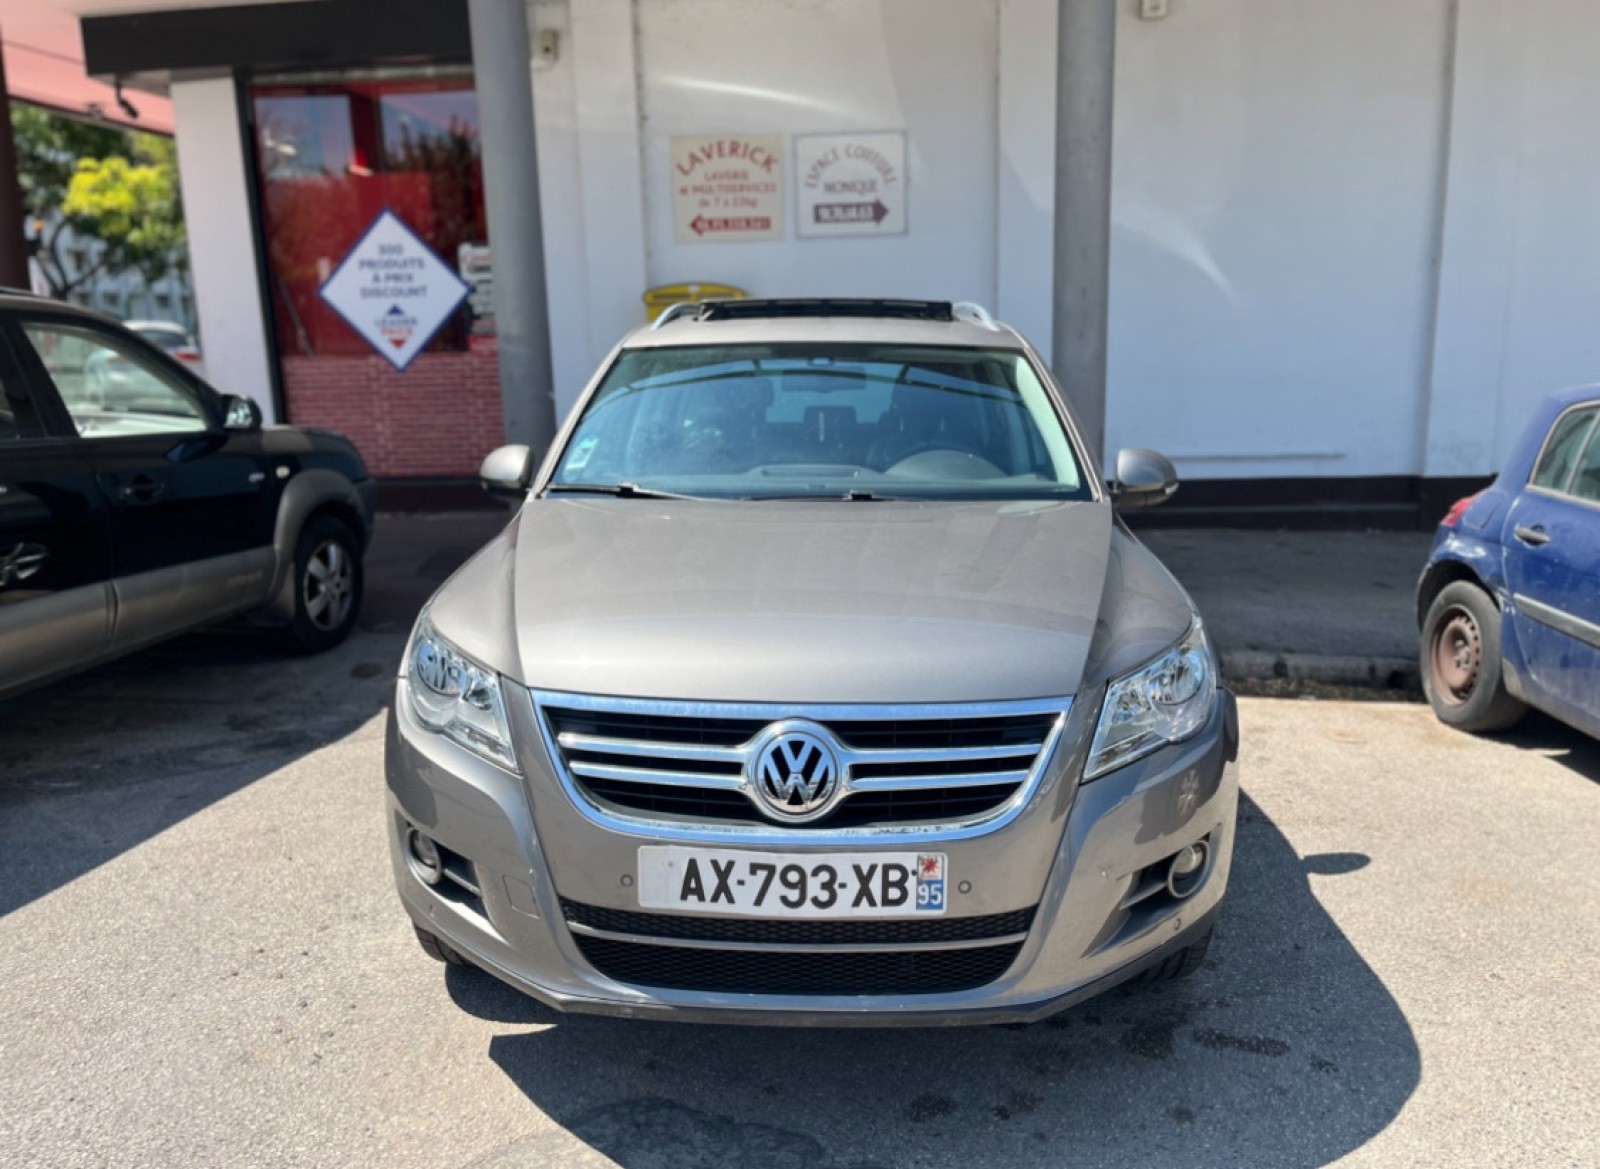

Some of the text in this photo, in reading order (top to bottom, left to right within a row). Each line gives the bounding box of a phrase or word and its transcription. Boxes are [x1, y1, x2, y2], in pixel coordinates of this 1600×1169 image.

[676, 139, 778, 176] LAVERICK
[804, 143, 897, 189] ESPACE COUTURE
[824, 181, 876, 195] MONIQUE
[359, 259, 424, 269] PRODUITS
[384, 272, 414, 283] PRIX
[361, 286, 427, 297] DISCOUNT
[679, 857, 910, 909] AX-793-XB
[917, 884, 943, 907] 95
